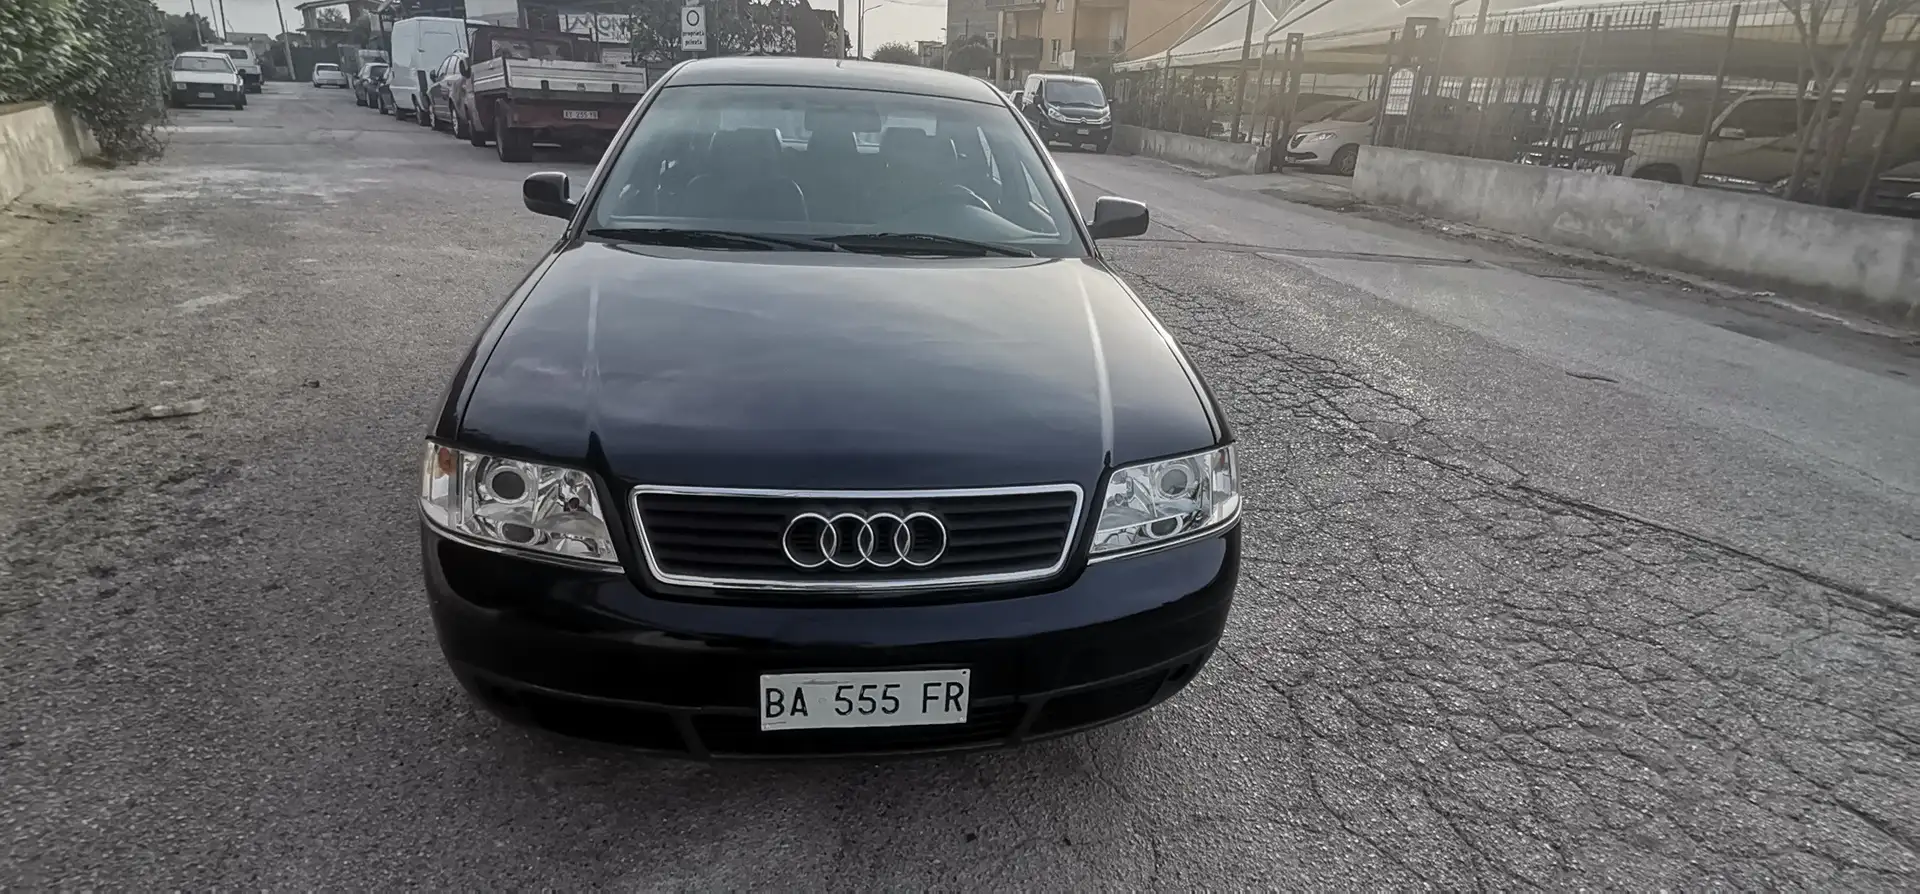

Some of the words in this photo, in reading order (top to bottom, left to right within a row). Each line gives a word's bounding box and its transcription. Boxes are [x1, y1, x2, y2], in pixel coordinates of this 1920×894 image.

[764, 686, 808, 718] BA
[834, 683, 901, 716] 555
[921, 681, 965, 714] FR
